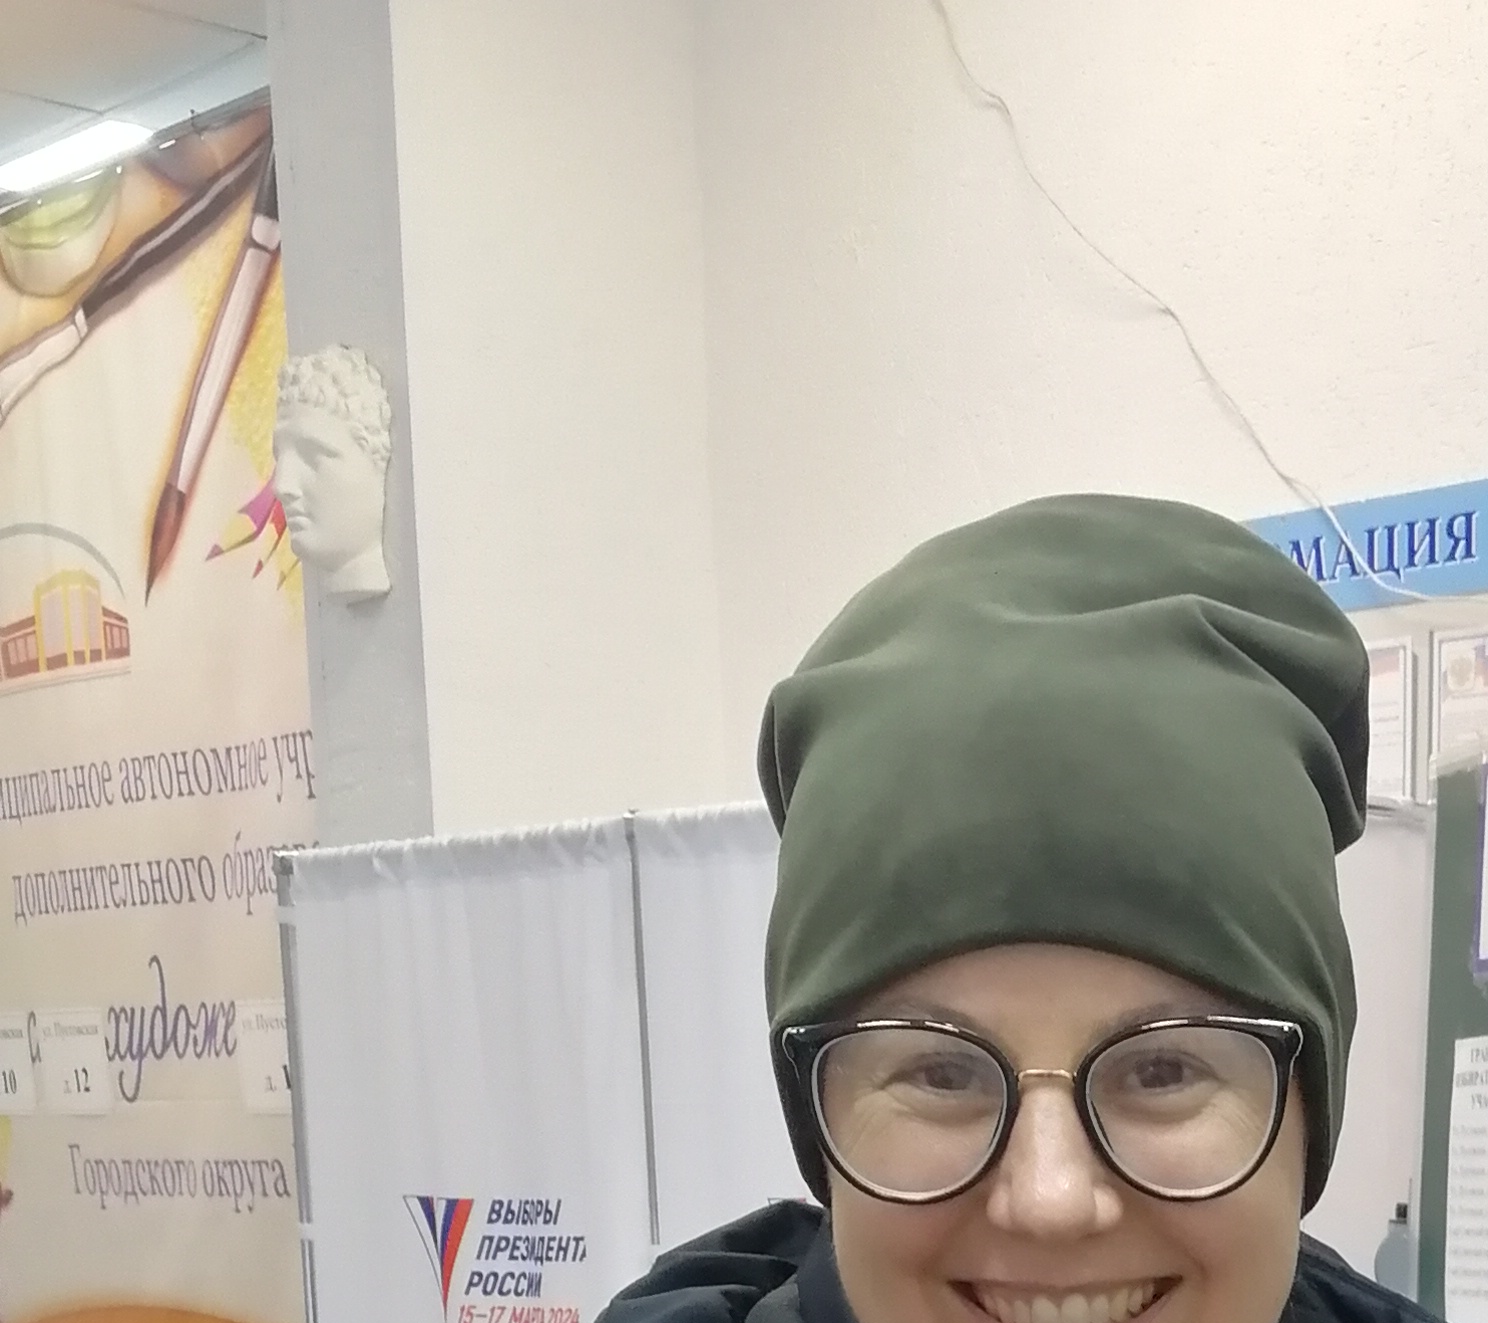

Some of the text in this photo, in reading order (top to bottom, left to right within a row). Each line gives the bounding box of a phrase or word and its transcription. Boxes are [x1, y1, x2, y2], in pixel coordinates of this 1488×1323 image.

[118, 737, 268, 804] автономное
[12, 855, 216, 926] дополнительного
[68, 1143, 292, 1213] Городского округа
[487, 1198, 562, 1225] ВЫБОРЫ
[464, 1270, 542, 1298] РОССИИ
